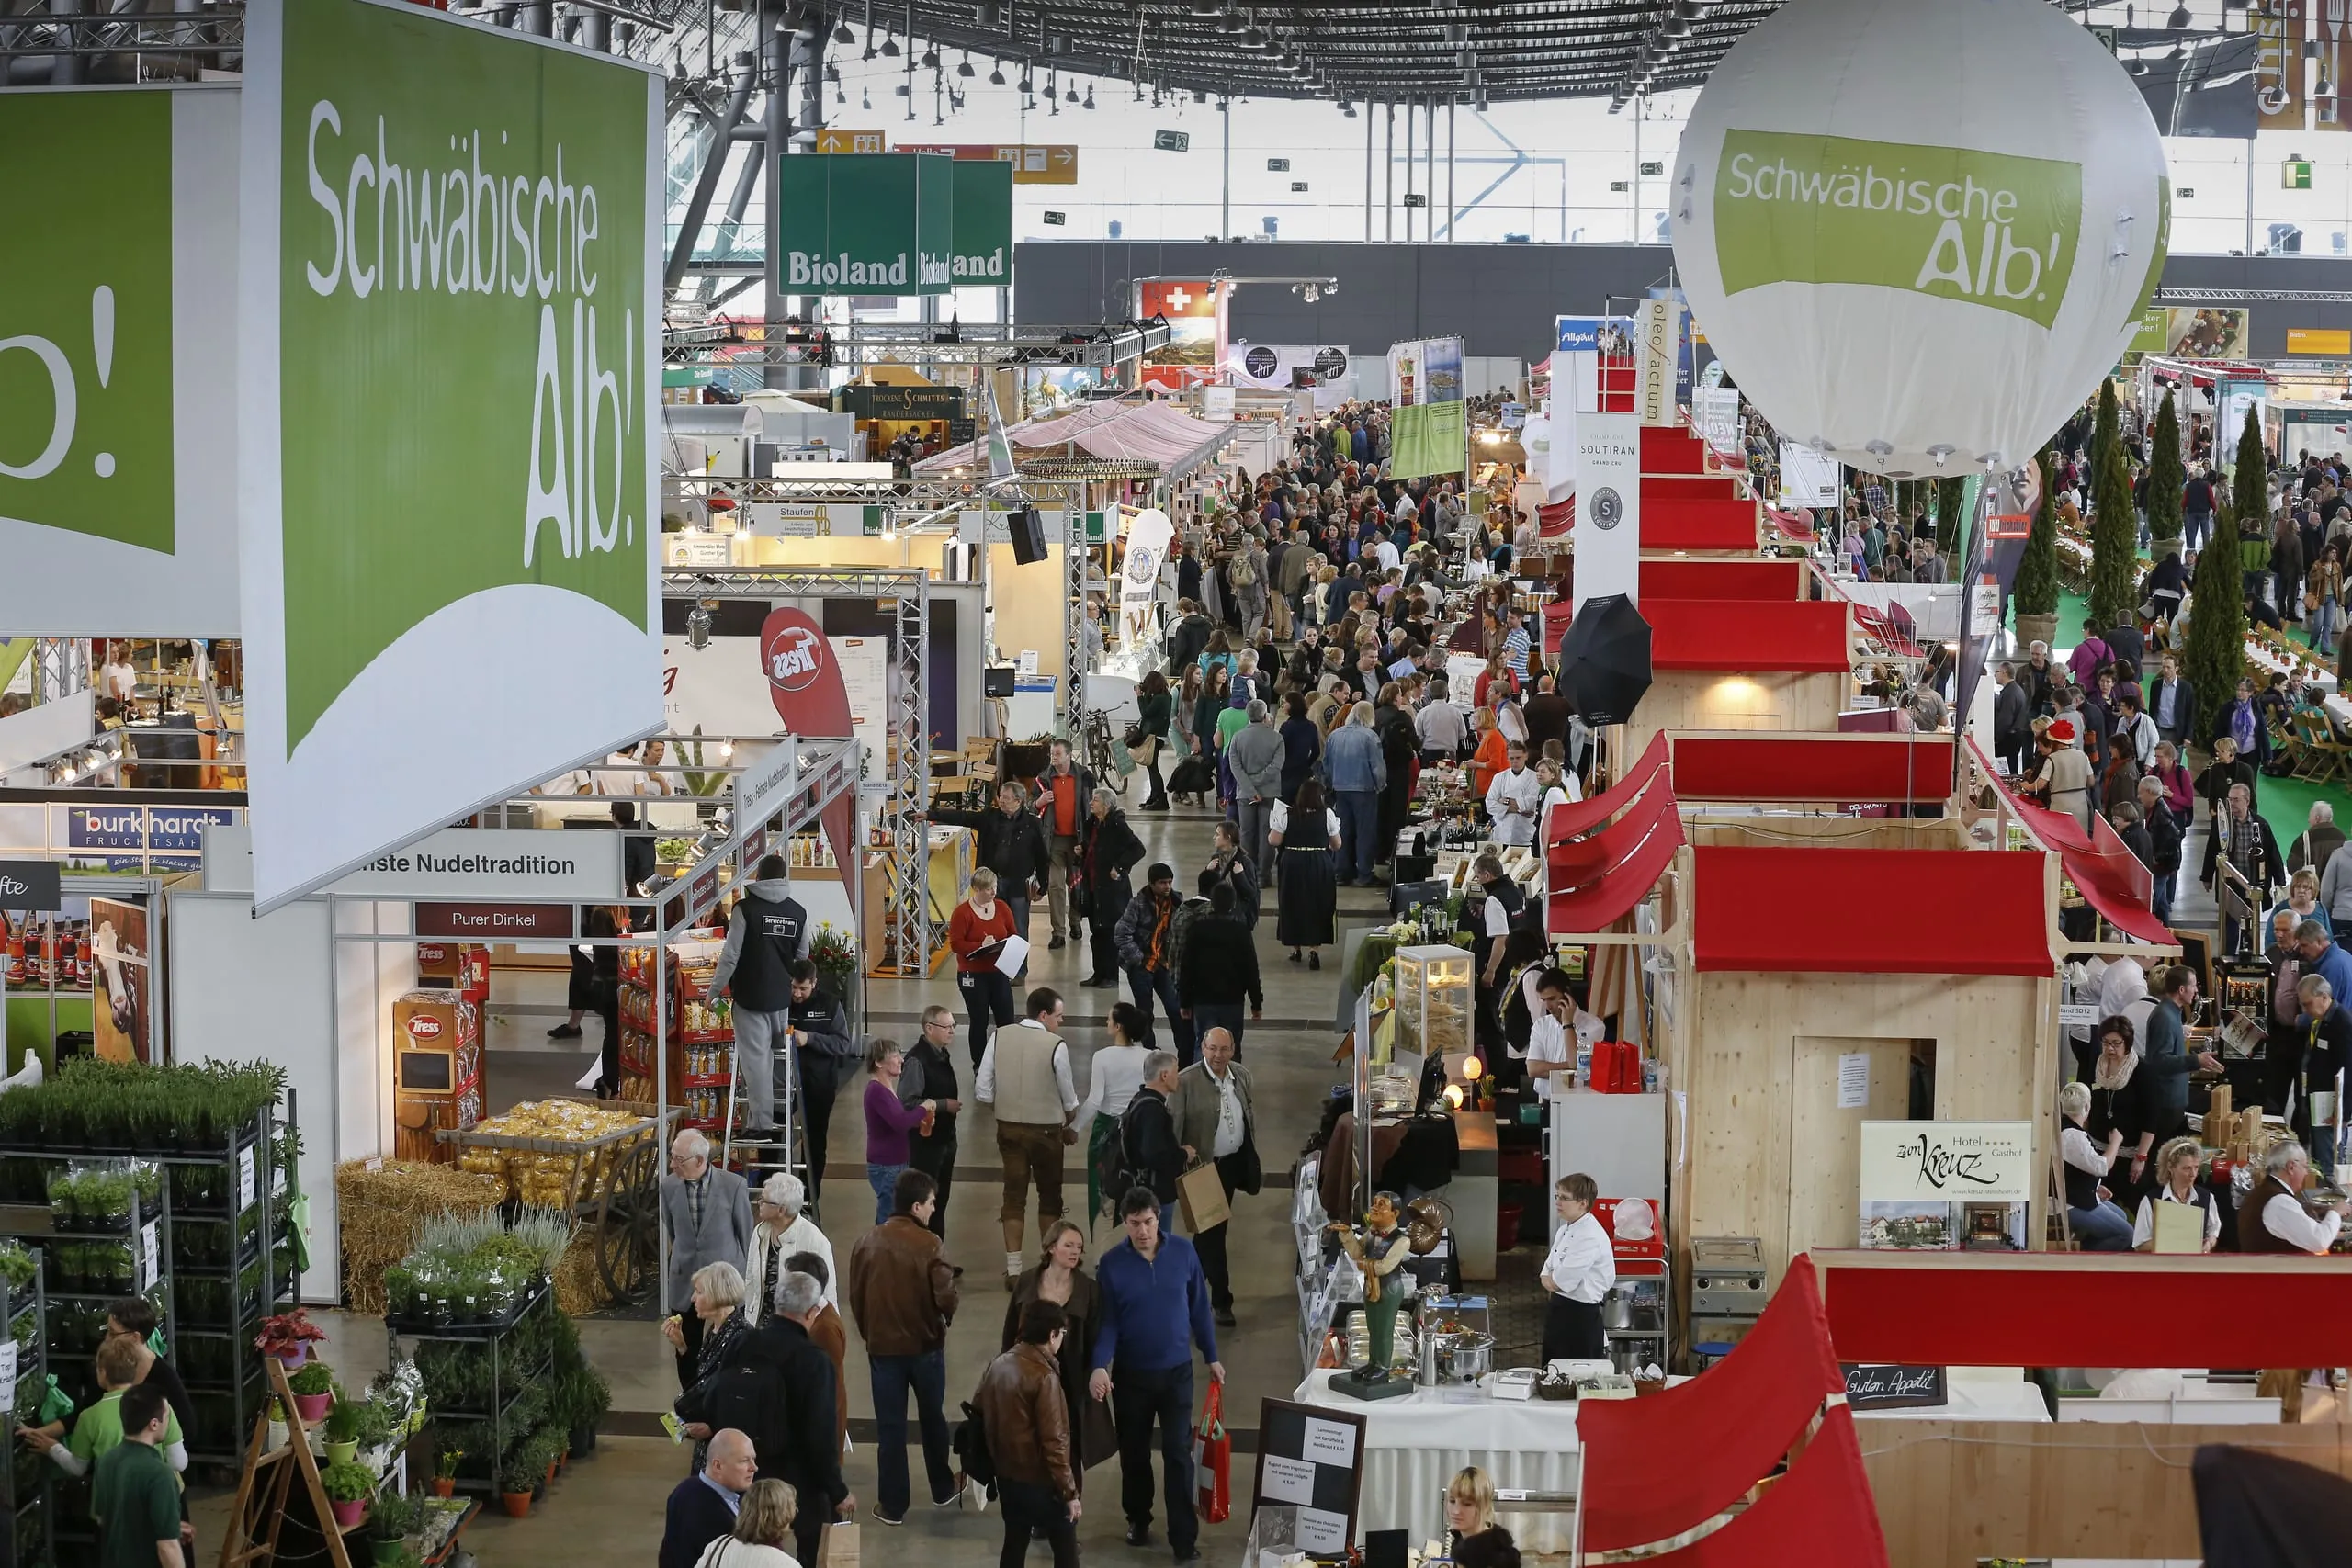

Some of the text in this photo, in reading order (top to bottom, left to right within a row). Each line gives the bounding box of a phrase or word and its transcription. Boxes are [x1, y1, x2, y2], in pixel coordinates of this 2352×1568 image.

[1729, 153, 2017, 223] Schwäbische
[307, 99, 598, 299] Schwäbische
[1915, 219, 2060, 301] Alb!
[788, 251, 907, 286] Bioland
[920, 252, 950, 286] Bioland
[1562, 332, 1594, 346] Allgäu
[873, 394, 902, 402] TROCKENE
[523, 298, 633, 569] Alb!
[1580, 445, 1634, 456] SOUTIRAN
[781, 507, 814, 516] Staufen
[1601, 502, 1611, 516] S
[114, 857, 129, 866] Ein
[416, 854, 575, 874] Nudeltradition
[452, 912, 536, 926] Purer Dinkel
[764, 917, 796, 926] Serviceteam
[418, 947, 444, 960] Tress
[412, 1019, 439, 1033] Tress
[1952, 1136, 1982, 1146] Hotel
[1991, 1148, 2022, 1157] Gasthof
[1896, 1134, 1999, 1189] zum Kreuz
[1845, 1371, 1884, 1393] Guten
